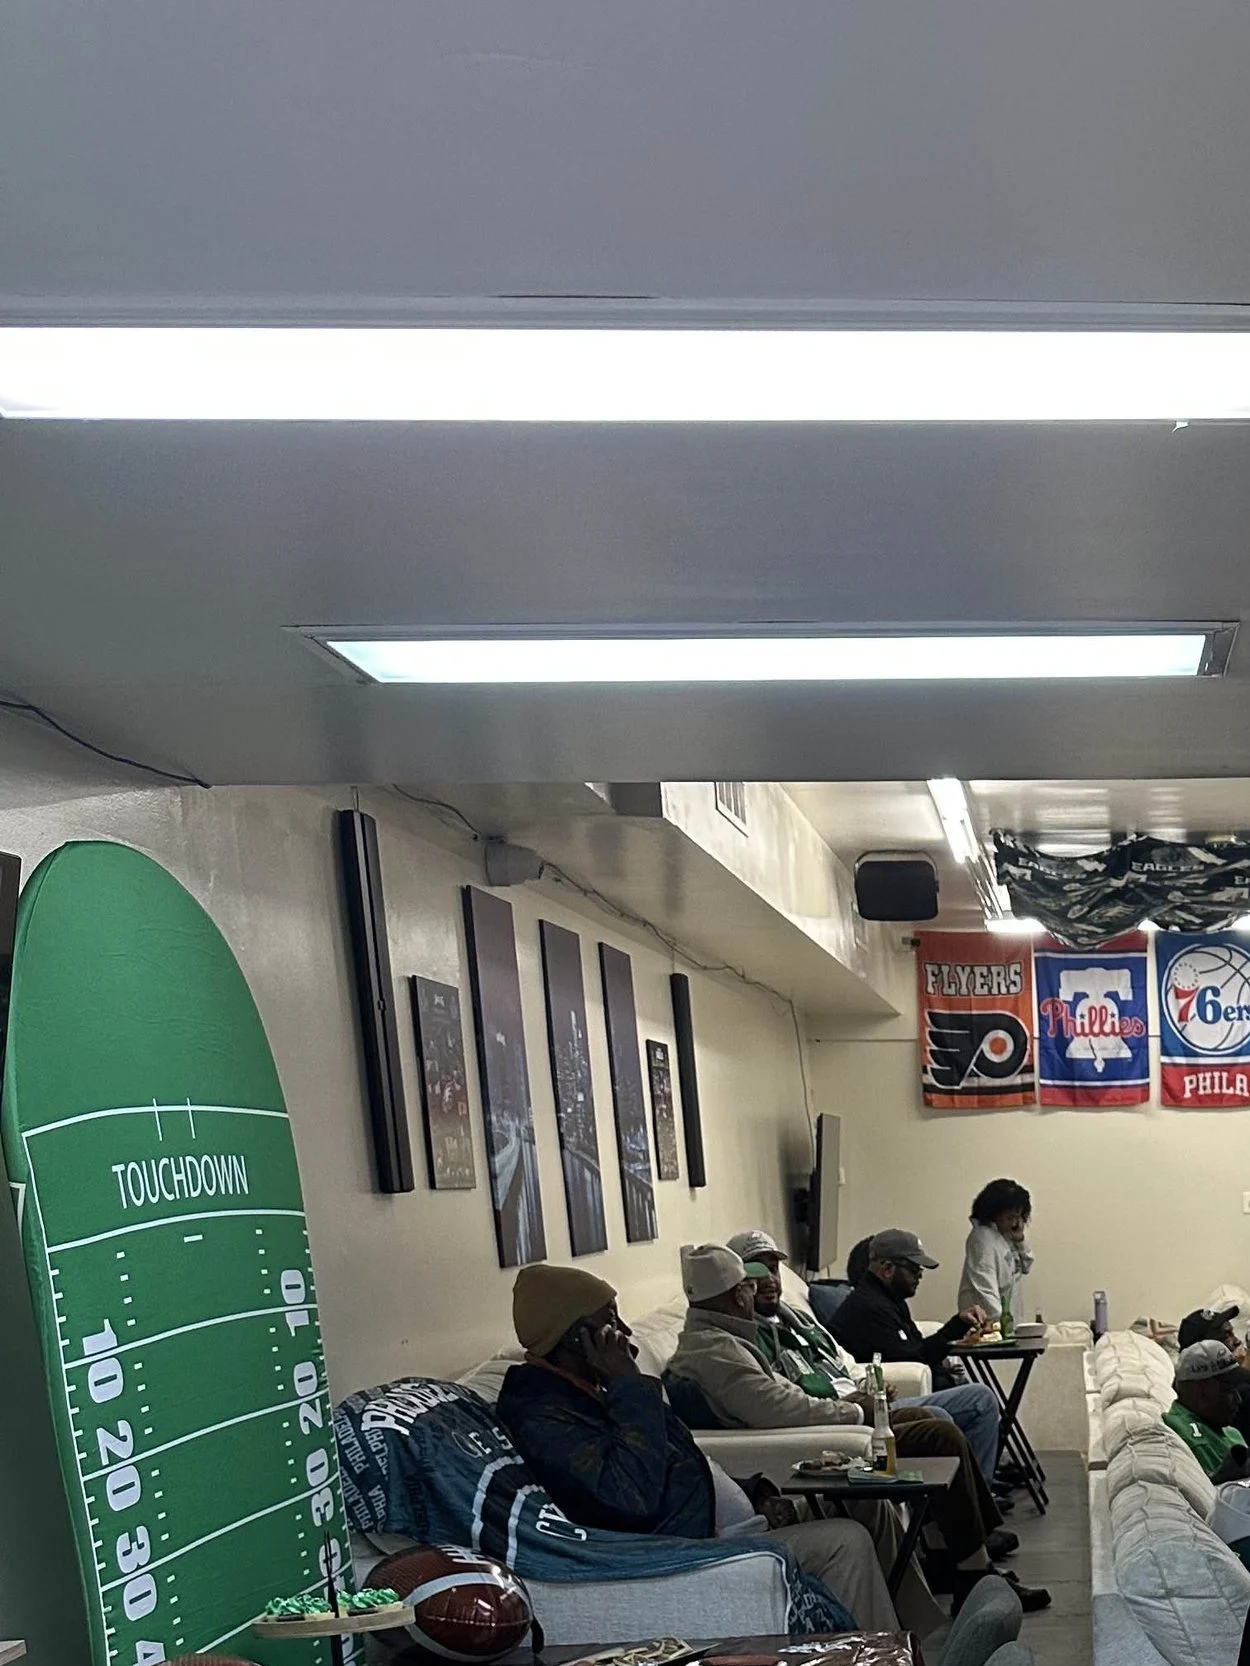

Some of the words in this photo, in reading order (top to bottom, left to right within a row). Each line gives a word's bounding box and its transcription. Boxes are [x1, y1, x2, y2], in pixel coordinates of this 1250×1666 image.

[924, 961, 1023, 997] FLYERS
[1040, 997, 1146, 1038] Phillies
[1183, 1071, 1250, 1098] PHILA
[112, 1154, 249, 1209] TOUCHDOWN
[280, 1269, 310, 1336] 10
[82, 1318, 124, 1403] 10
[293, 1361, 324, 1435] 20
[97, 1420, 141, 1512] 20
[306, 1448, 335, 1527] 30
[116, 1525, 157, 1621] 30
